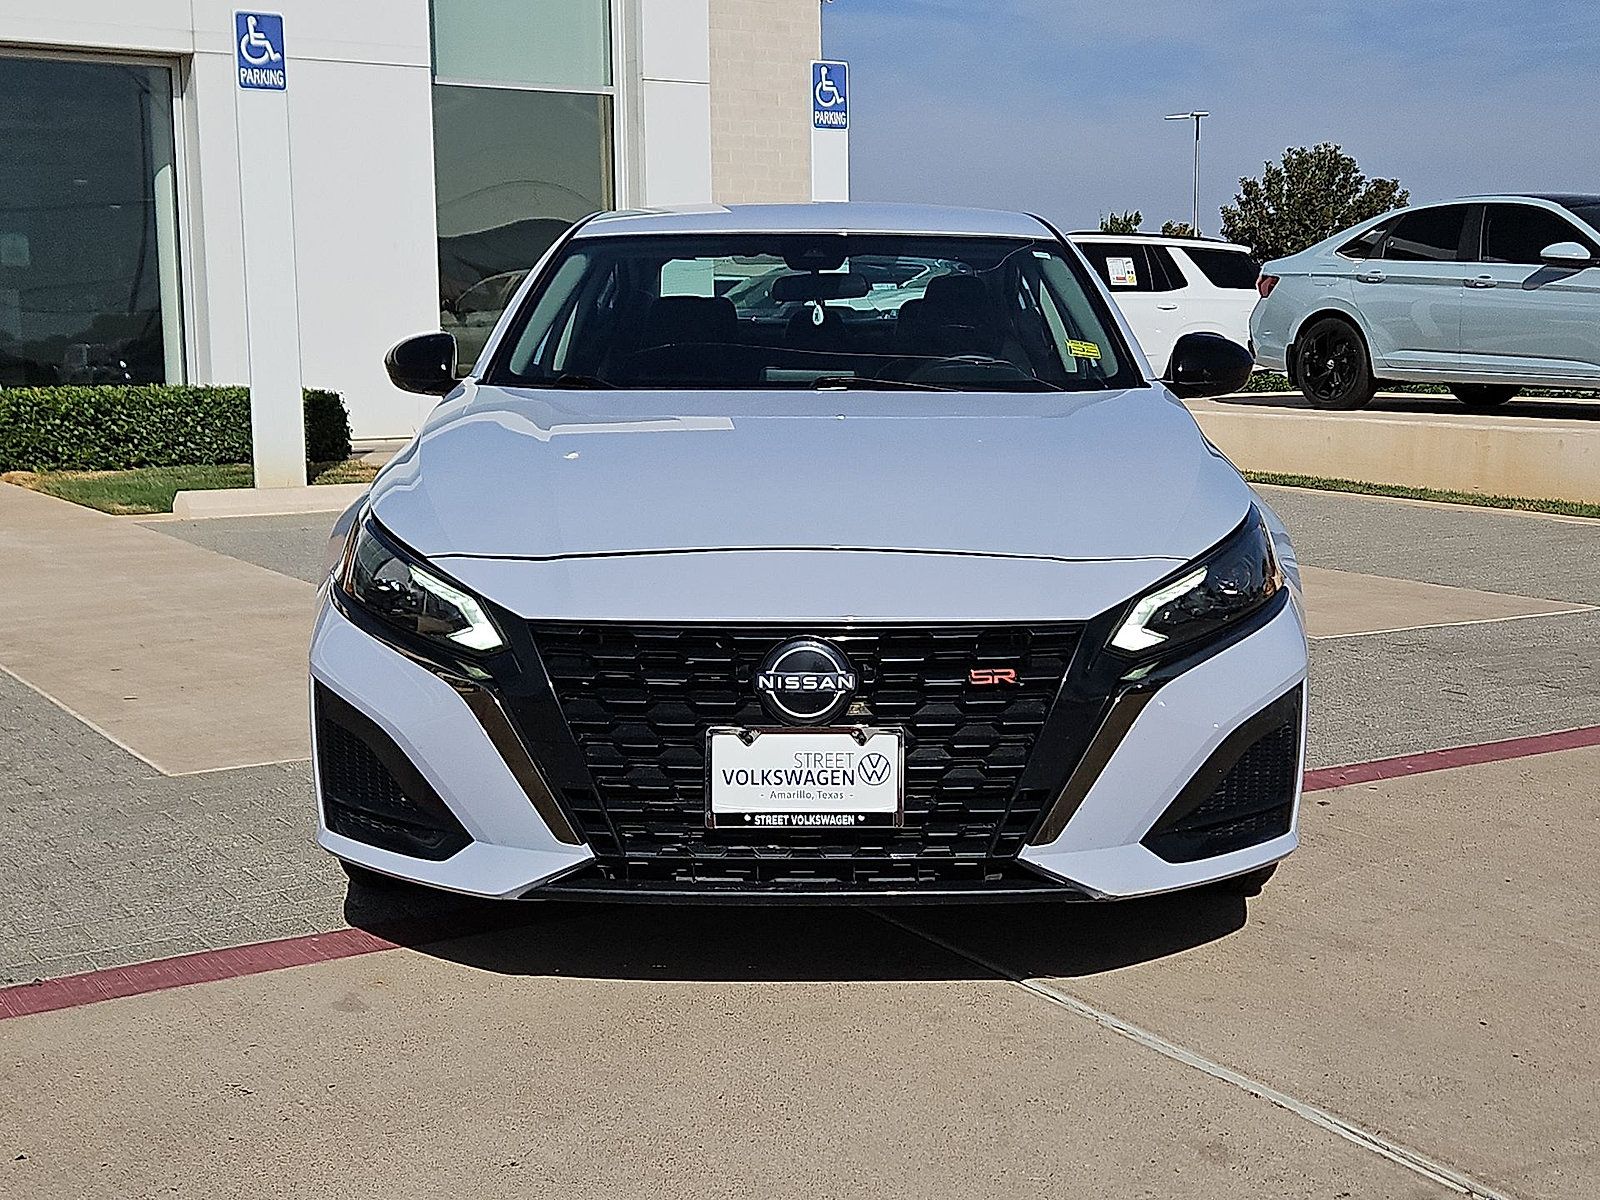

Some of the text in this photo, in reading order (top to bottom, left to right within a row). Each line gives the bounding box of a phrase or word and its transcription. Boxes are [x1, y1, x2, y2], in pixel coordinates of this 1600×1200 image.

[240, 67, 284, 86] PARKING
[814, 110, 846, 125] PARKING
[758, 675, 854, 690] NISSAN
[969, 668, 1017, 685] SR
[794, 752, 855, 768] STREET
[722, 769, 855, 786] VOLKSWAGEN
[769, 790, 844, 800] Amarillo, Texas
[754, 814, 855, 826] STREET VOLKSWAGEN
